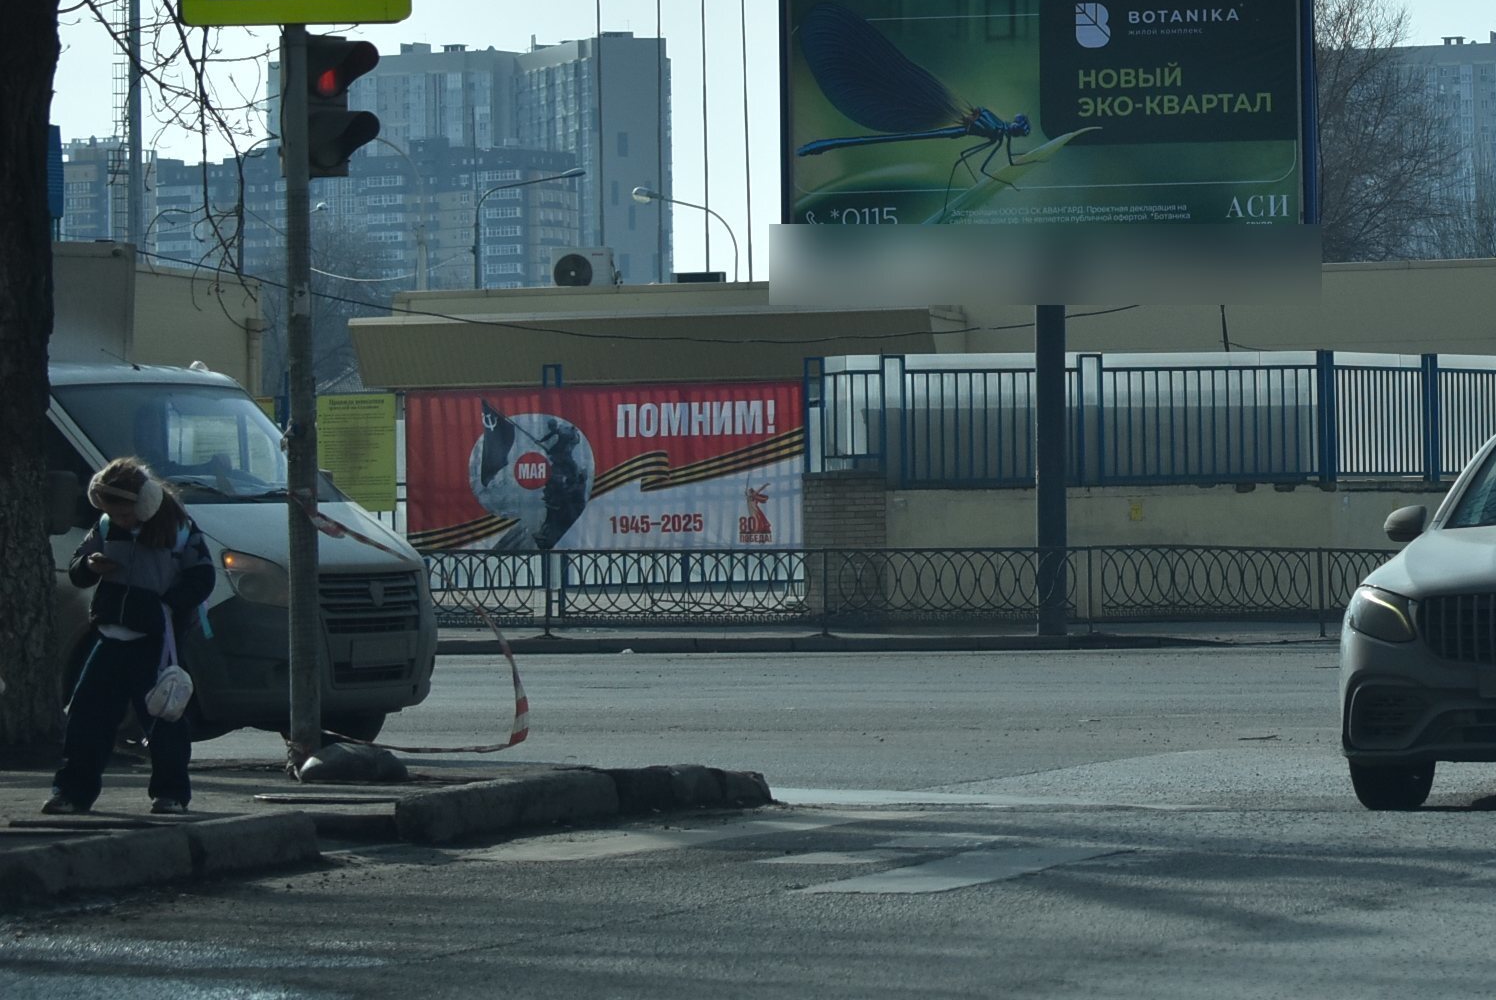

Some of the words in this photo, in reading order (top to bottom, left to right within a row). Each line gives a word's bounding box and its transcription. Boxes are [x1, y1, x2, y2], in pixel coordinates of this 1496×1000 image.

[1128, 8, 1239, 24] BOTANIKA
[1128, 28, 1157, 36] жилой
[1160, 27, 1203, 35] комплекс
[1078, 62, 1182, 89] НОВЫЙ
[1077, 92, 1272, 117] ЭКО-КВАРТАЛ
[1225, 194, 1289, 218] АСИ
[617, 400, 775, 437] ПОМНИМ!
[518, 462, 546, 479] МАЯ
[739, 516, 756, 533] 80
[739, 534, 772, 544] ПОБЕДА!
